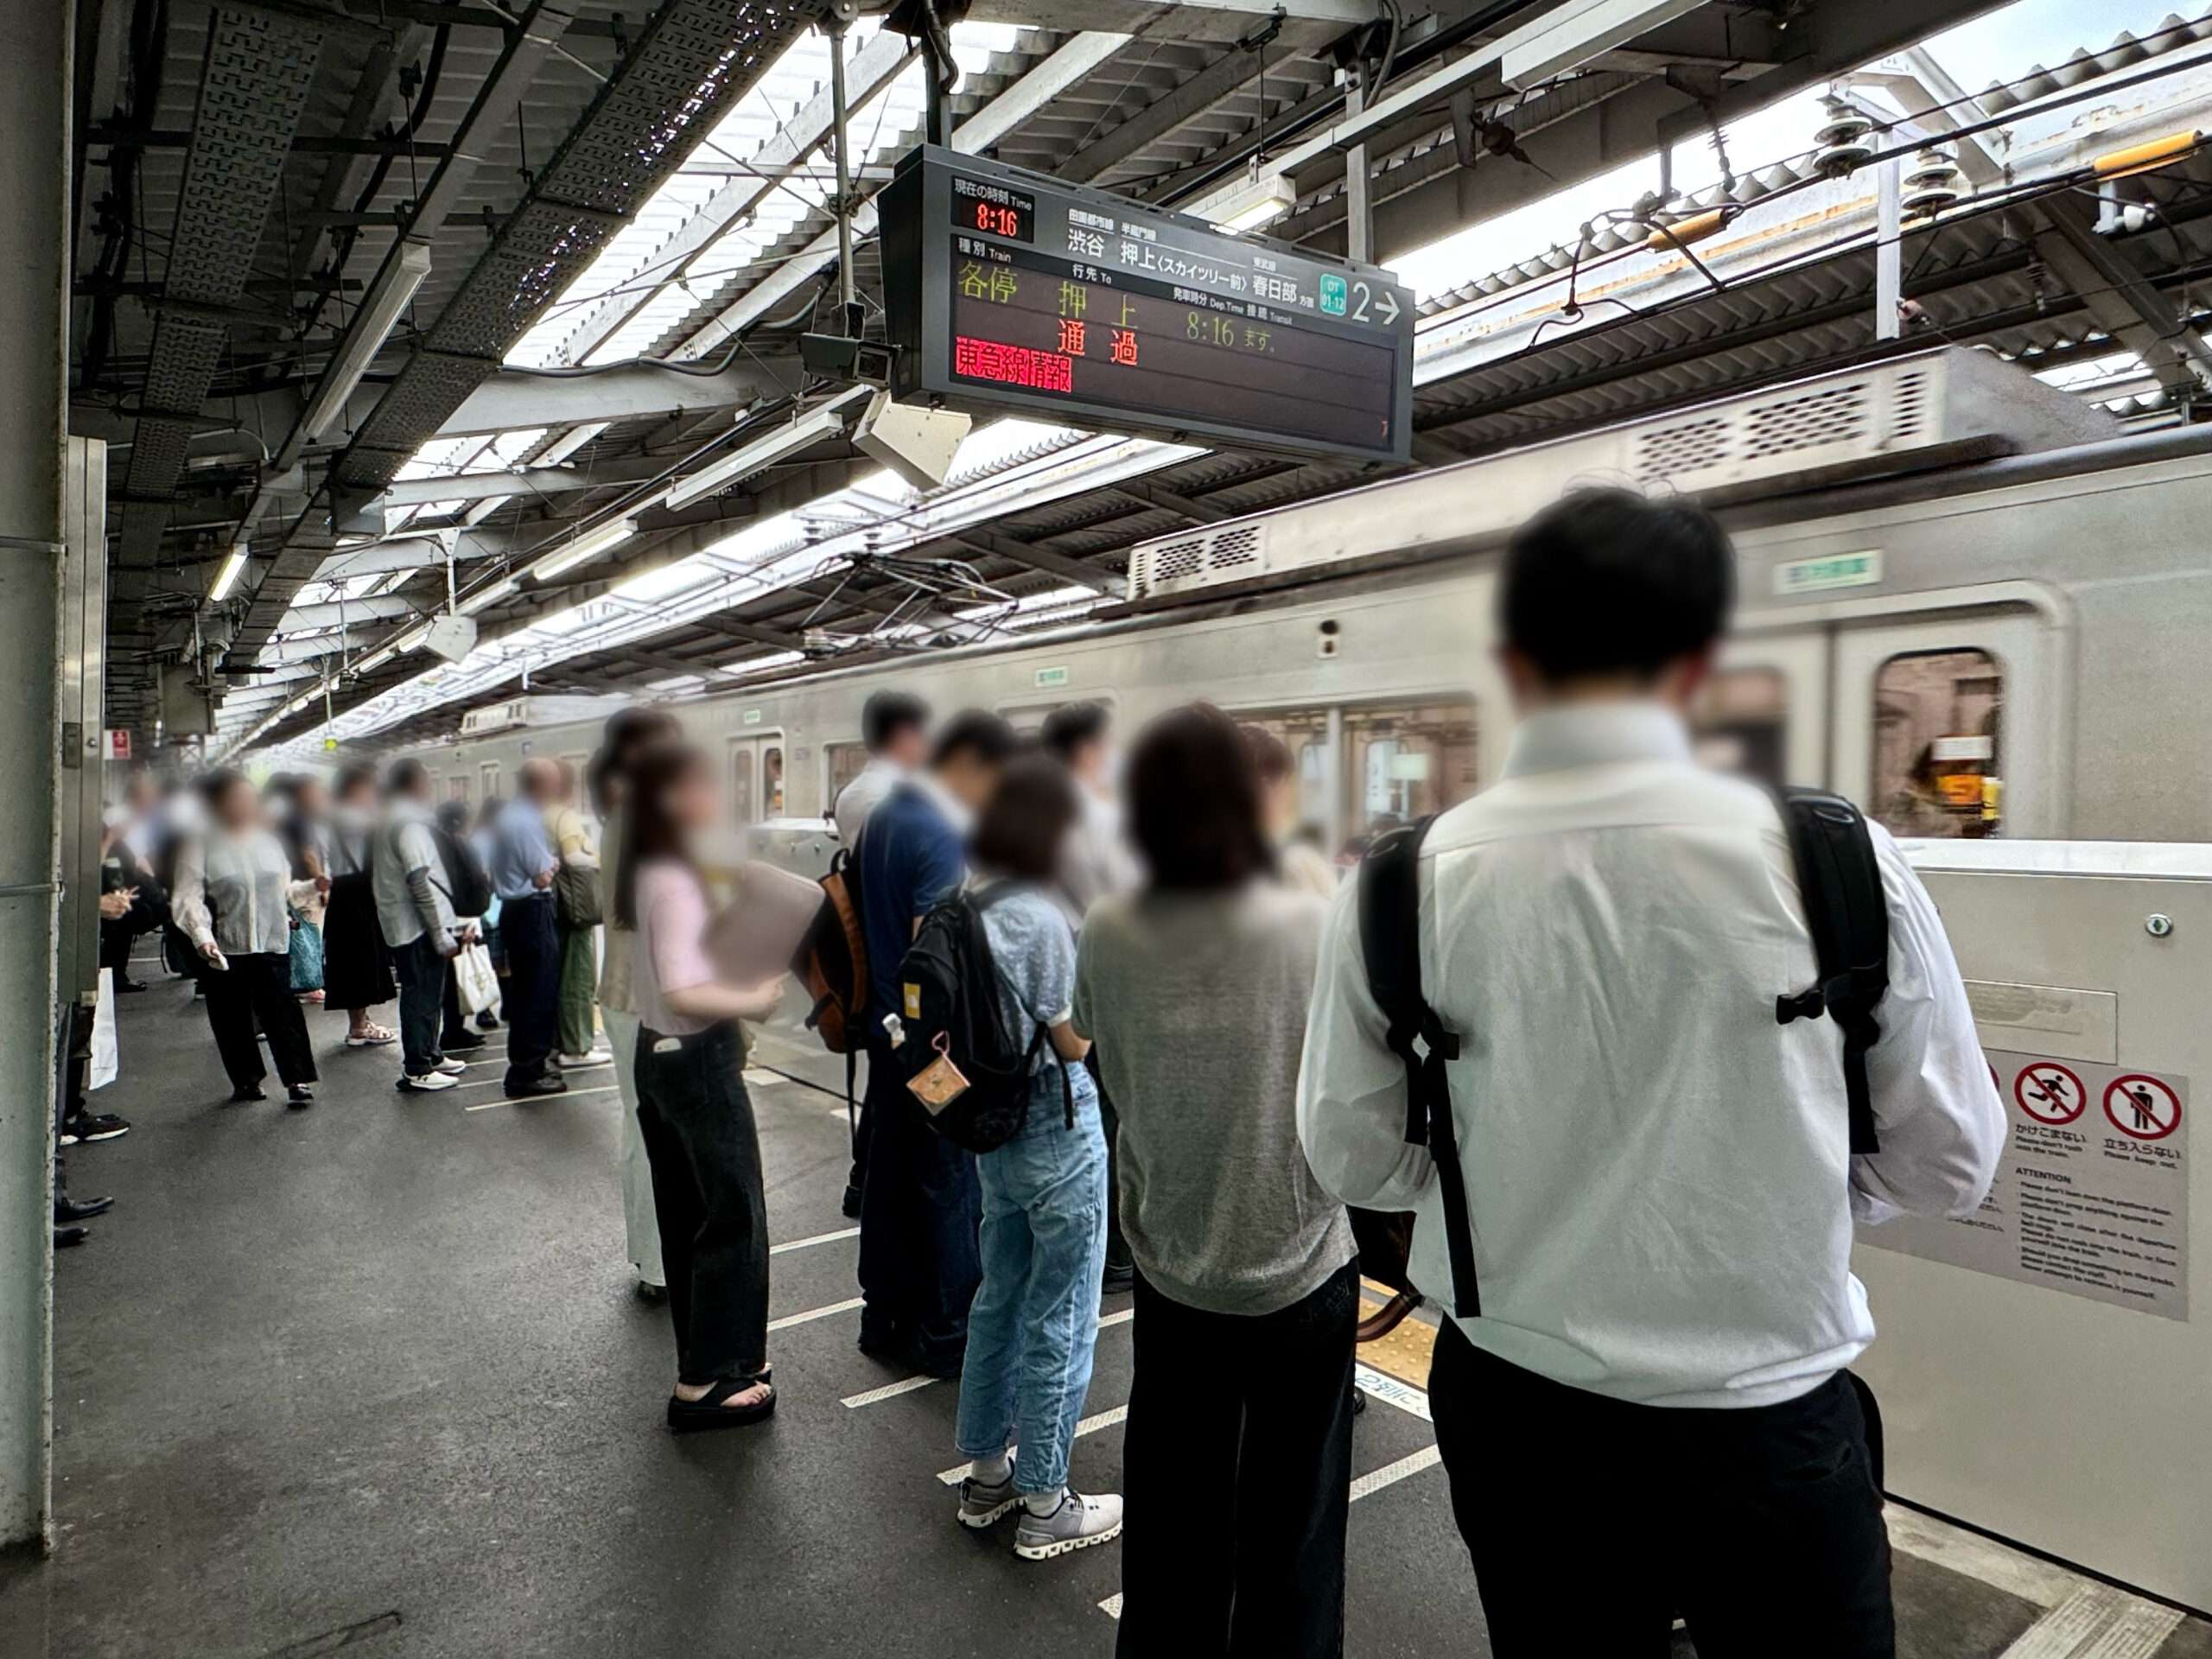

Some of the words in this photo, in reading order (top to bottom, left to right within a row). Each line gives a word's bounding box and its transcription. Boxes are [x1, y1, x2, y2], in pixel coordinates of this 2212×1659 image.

[954, 178, 1008, 205] 現在の時刻
[1011, 196, 1033, 210] Time
[977, 203, 1017, 238] 8:16
[988, 247, 1011, 263] Train
[1068, 227, 1105, 258] 渋谷
[958, 260, 1018, 304] 各停
[1100, 273, 1112, 284] To
[1253, 275, 1297, 304] 春日部
[1327, 279, 1340, 293] DT
[1351, 282, 1370, 323] 2
[1187, 311, 1235, 346] 8:16
[957, 340, 1072, 393] 東急線情報
[2016, 1123, 2087, 1142] かけこまない
[2103, 1137, 2182, 1160] 立ち入らない
[2016, 1166, 2071, 1184] ATTENTION
